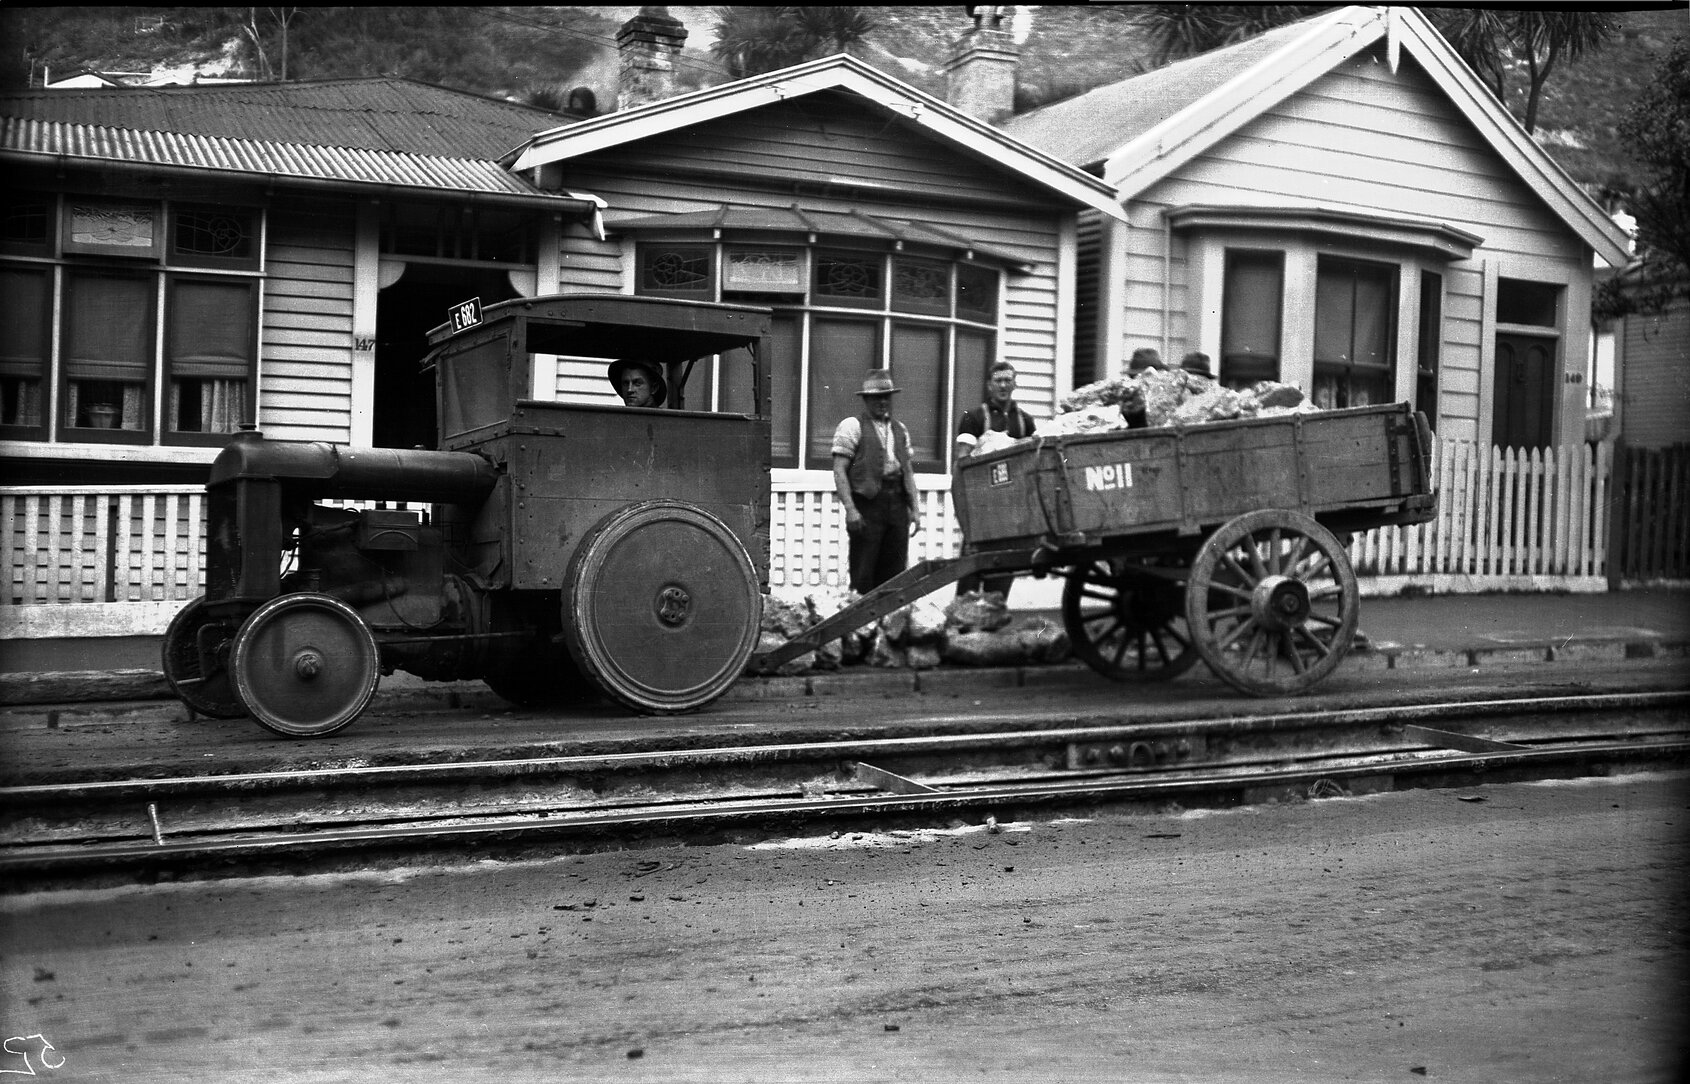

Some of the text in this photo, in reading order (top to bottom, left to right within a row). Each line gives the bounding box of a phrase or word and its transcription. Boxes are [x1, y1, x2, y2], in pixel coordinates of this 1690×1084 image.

[455, 302, 477, 329] E 682
[355, 338, 375, 351] 147
